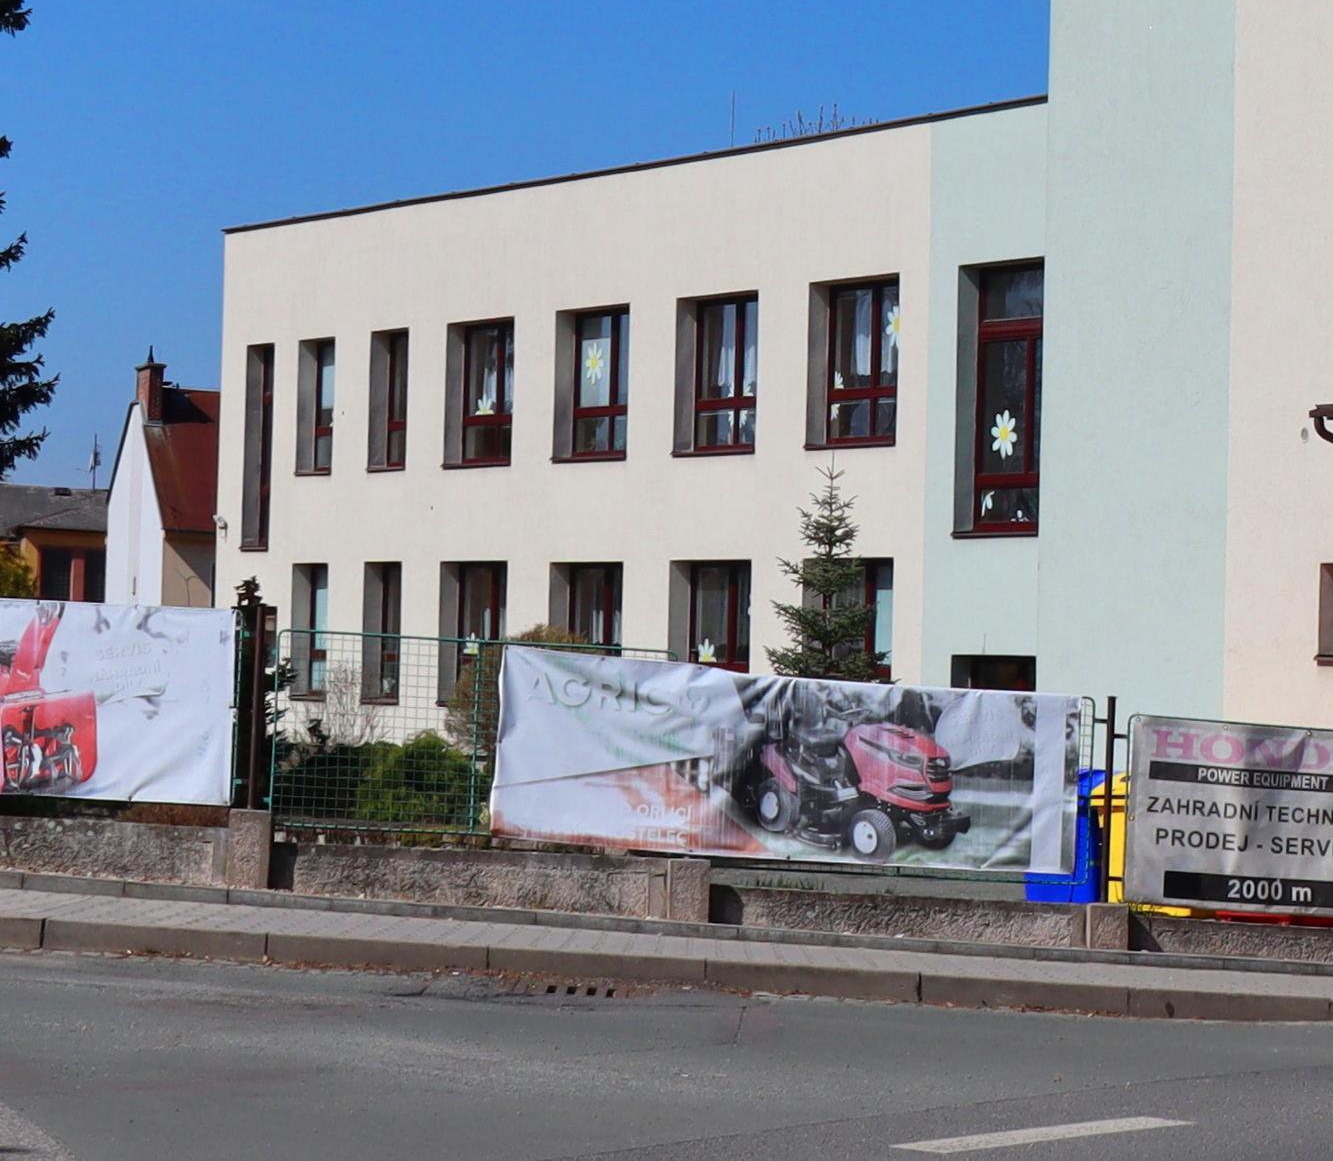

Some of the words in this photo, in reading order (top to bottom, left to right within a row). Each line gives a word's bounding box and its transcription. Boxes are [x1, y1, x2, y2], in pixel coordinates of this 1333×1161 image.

[1197, 767, 1250, 785] POWER
[1253, 771, 1330, 791] EQUIPMENT
[1146, 796, 1259, 821] ZAHRADNÍ
[1155, 827, 1249, 852] PRODEJ
[1227, 878, 1283, 901] 2000
[1290, 885, 1312, 903] m
